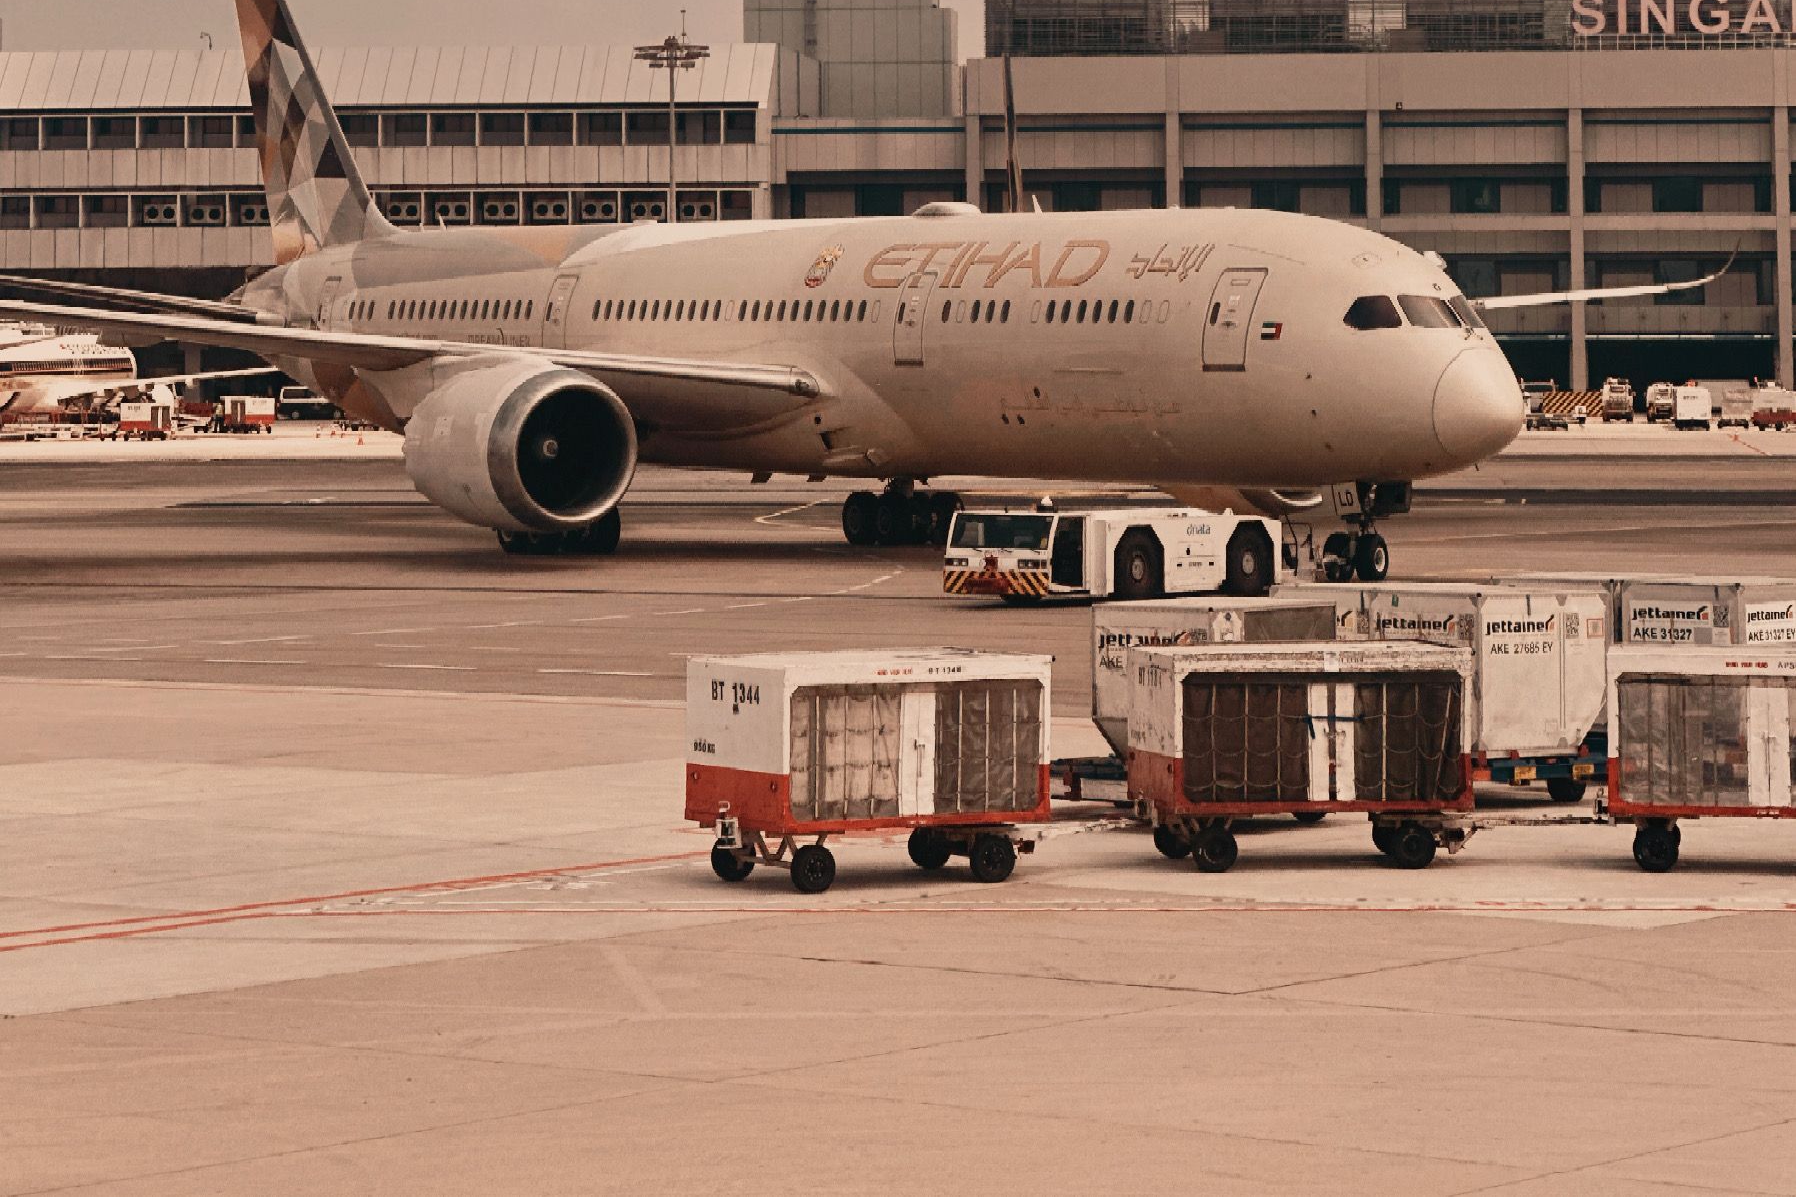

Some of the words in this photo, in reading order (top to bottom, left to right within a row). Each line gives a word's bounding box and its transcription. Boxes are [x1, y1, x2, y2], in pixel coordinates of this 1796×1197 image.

[863, 239, 1111, 289] ETIHAD
[1631, 605, 1708, 621] jettainer
[1747, 604, 1793, 623] jettainer
[1375, 614, 1455, 632] jettainer
[1485, 614, 1555, 635] jettainer
[1633, 627, 1657, 639] AKE
[1660, 627, 1693, 640] 31327
[1748, 631, 1764, 641] AKE
[1490, 643, 1509, 654] AKE
[1542, 642, 1554, 654] EY
[1099, 655, 1124, 669] AKE
[711, 679, 725, 701] BT
[731, 682, 760, 705] 1344
